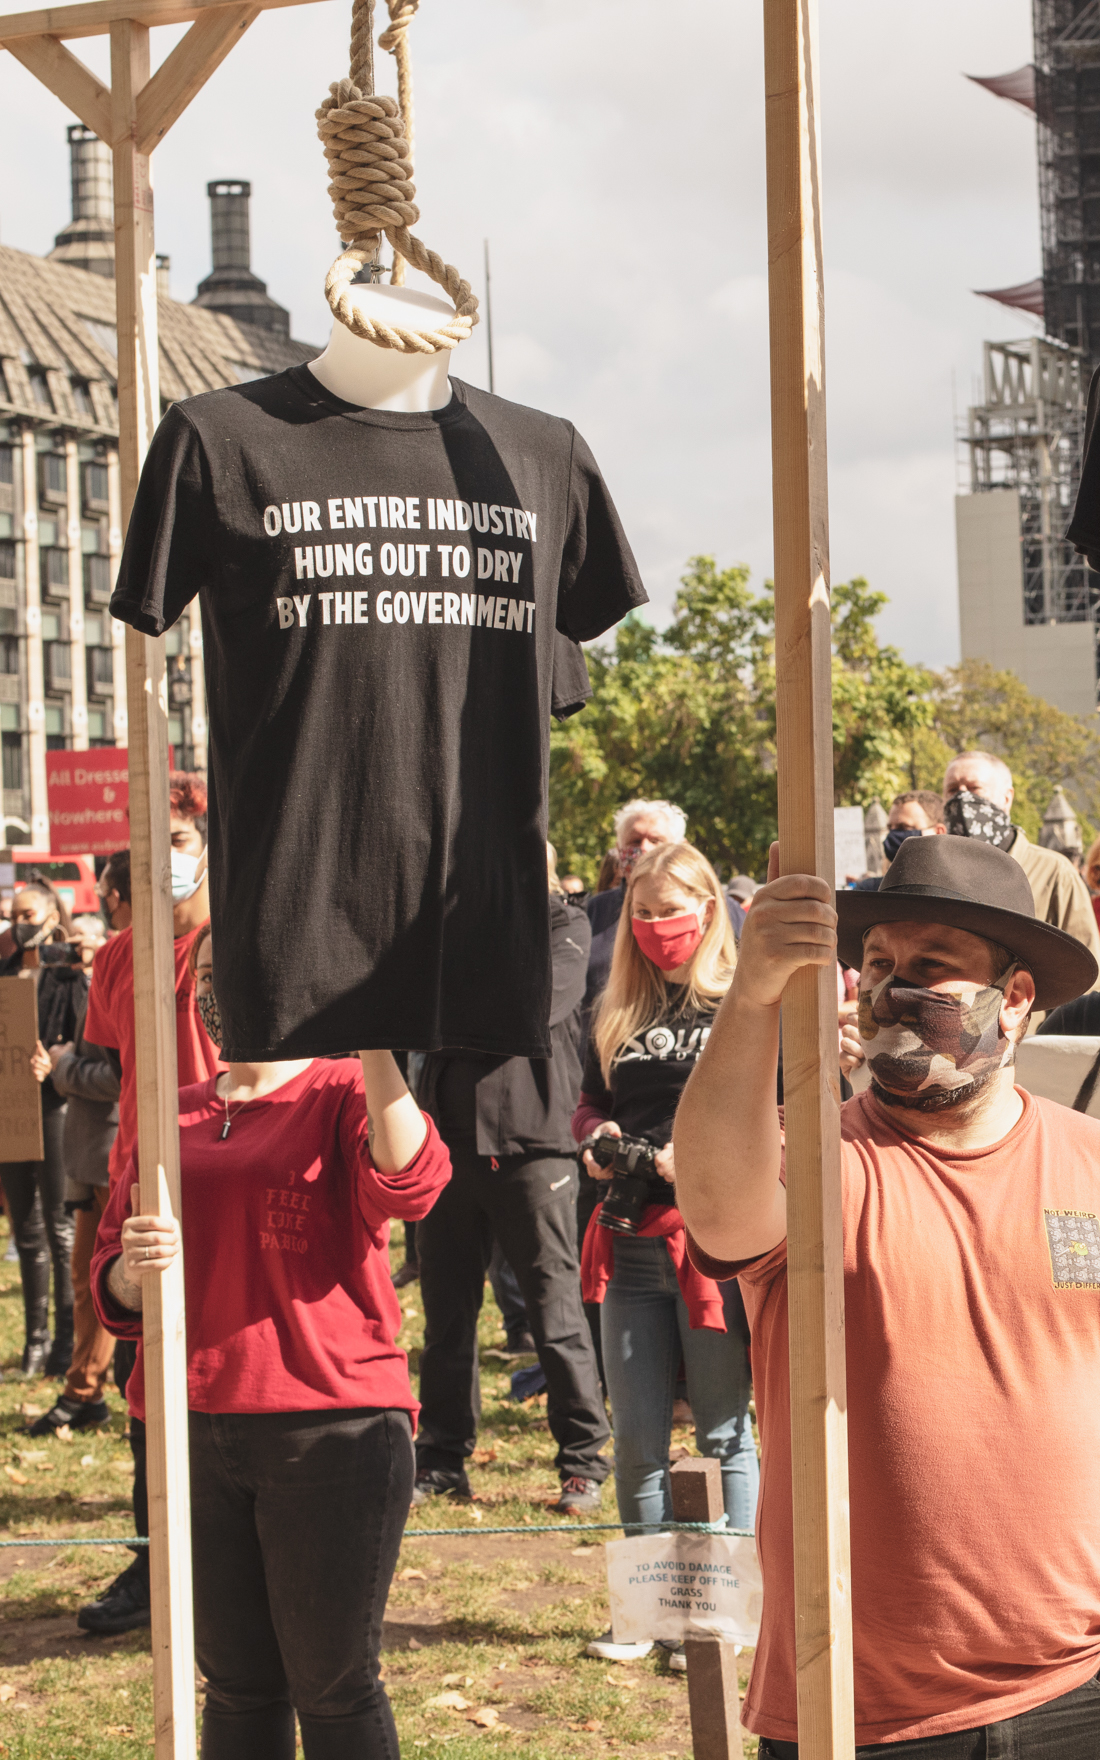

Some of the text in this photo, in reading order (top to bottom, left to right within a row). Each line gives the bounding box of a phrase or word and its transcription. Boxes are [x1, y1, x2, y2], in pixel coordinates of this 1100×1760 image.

[264, 496, 537, 543] OUR ENTIRE INDUSTRY
[294, 542, 523, 583] HUNG OUT TO DRY
[276, 590, 536, 633] BY THE GOVERNMENT
[48, 769, 72, 787] All
[265, 1188, 312, 1213] FEEL
[266, 1210, 306, 1232] LIKE
[1043, 1208, 1097, 1219] NOT WEIRD
[259, 1230, 309, 1255] PABLO
[1054, 1280, 1073, 1290] JUST
[635, 1561, 733, 1575] TO AVOID DAMAGE
[628, 1573, 741, 1589] PLEASE KEEP OFF THE
[670, 1586, 703, 1599] GRASS
[658, 1597, 717, 1612] THANK YOU
